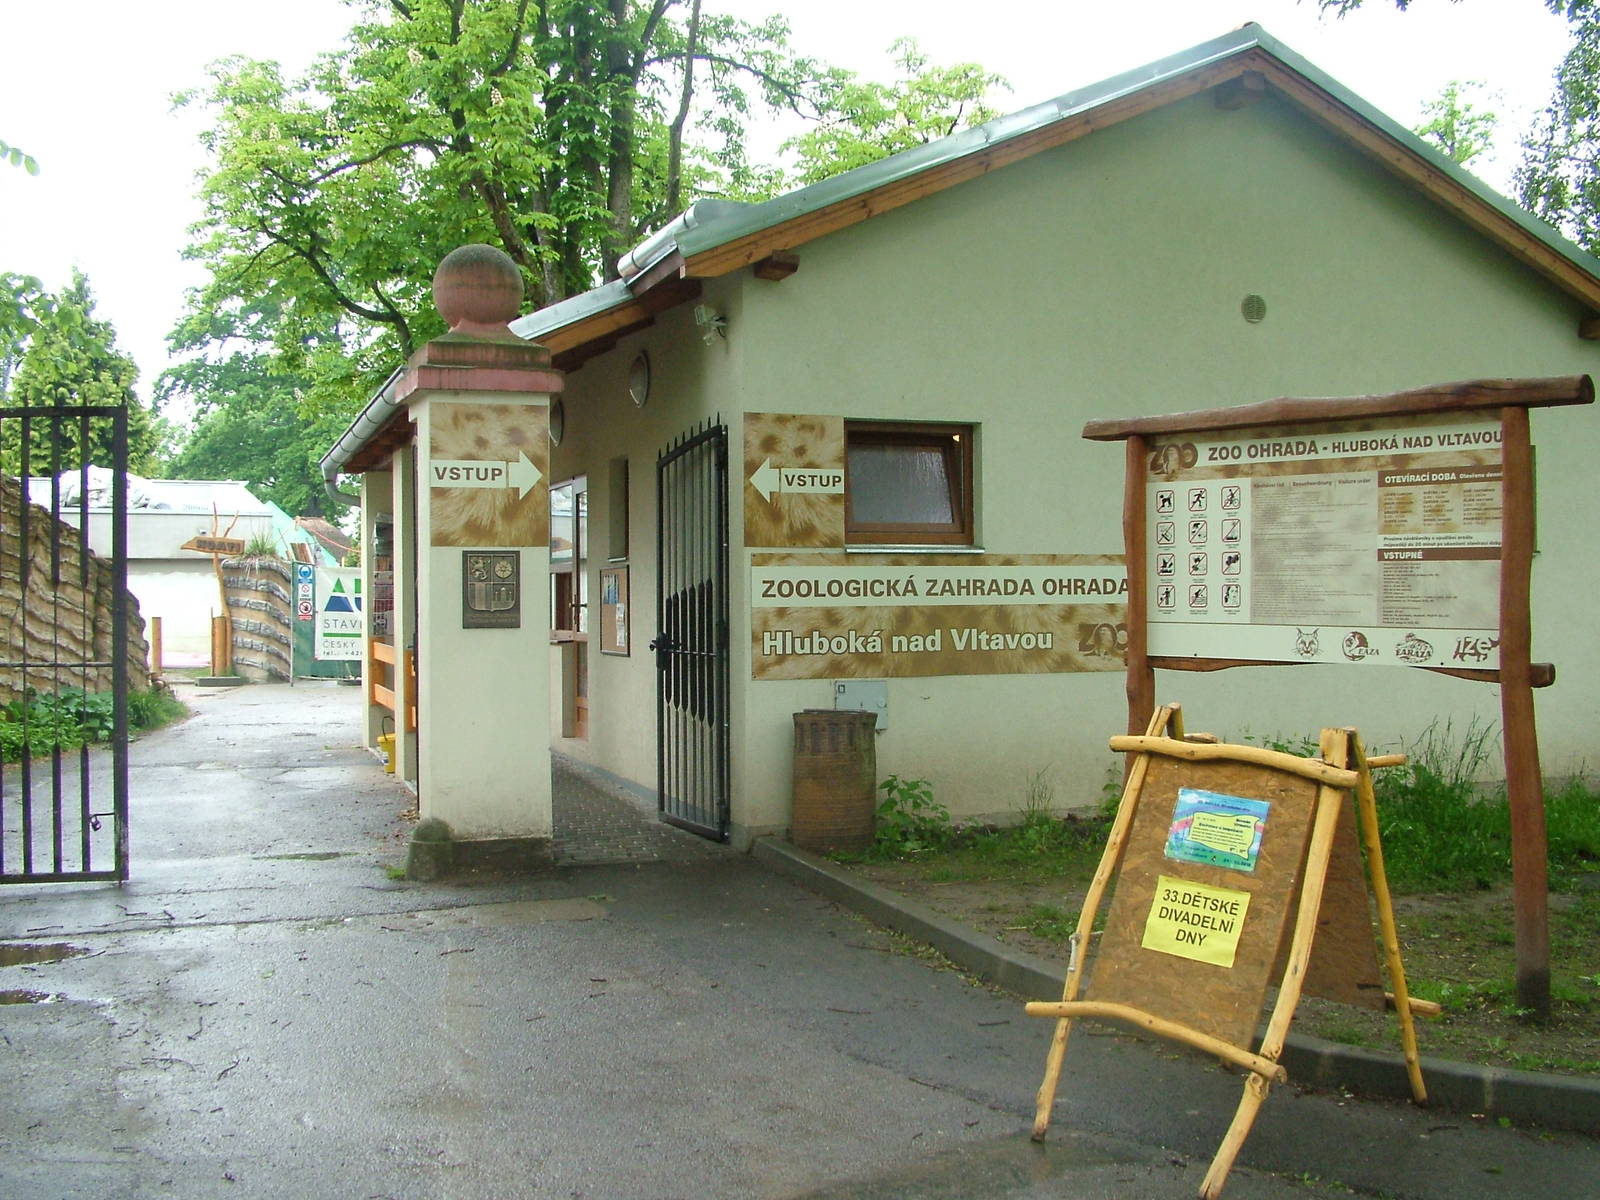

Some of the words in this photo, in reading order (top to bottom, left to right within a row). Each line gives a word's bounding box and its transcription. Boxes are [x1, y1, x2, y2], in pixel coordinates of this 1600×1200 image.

[1208, 445, 1242, 462] ZOO
[1247, 440, 1319, 459] OHRADA
[1332, 434, 1398, 453] HLUBOKÁ
[1403, 435, 1433, 449] NAD
[1437, 430, 1503, 447] VLTAVOU
[434, 466, 503, 481] VSTUP
[784, 474, 842, 487] VSTUP
[1384, 472, 1430, 484] OTEVÍRACÍ
[1431, 472, 1456, 481] DOBA
[1383, 549, 1423, 560] VSTUPNÉ
[761, 575, 919, 598] ZOOLOGICKÁ
[925, 578, 1035, 598] ZAHRADA
[1041, 577, 1128, 596] OHRADA
[762, 628, 883, 656] Hluboká
[891, 629, 941, 653] nad
[950, 628, 1054, 652] Vltavou
[1358, 648, 1380, 656] EAZA
[1158, 906, 1235, 934] DIVADELNÍ
[1175, 928, 1207, 946] DNY
